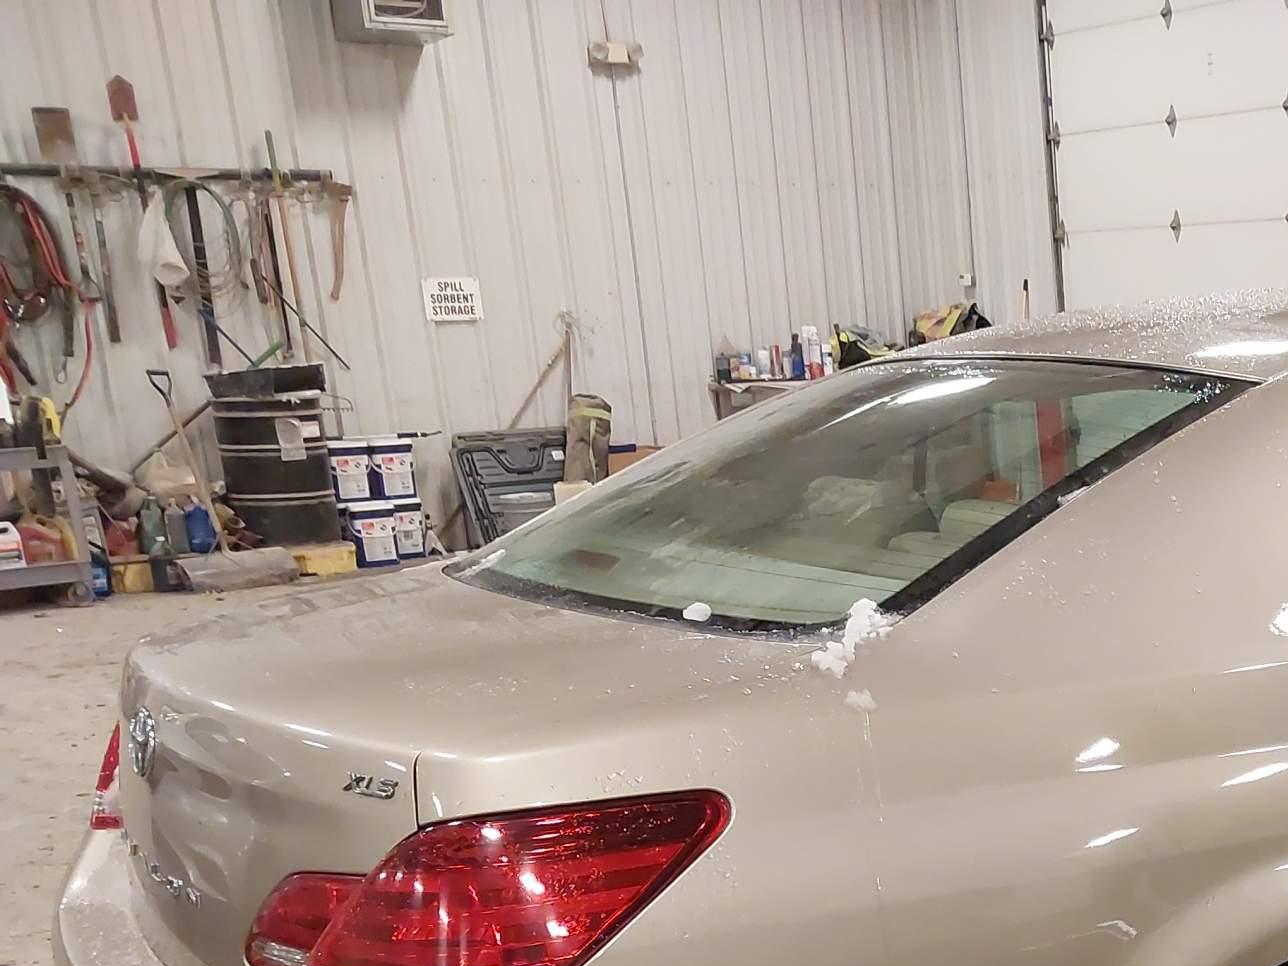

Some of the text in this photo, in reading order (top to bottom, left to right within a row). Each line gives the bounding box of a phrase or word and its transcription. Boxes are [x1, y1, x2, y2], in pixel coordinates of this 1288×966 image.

[437, 281, 465, 293] SPILL
[430, 293, 475, 305] SORBENT
[432, 305, 477, 317] STORAGE
[342, 772, 399, 800] XLS
